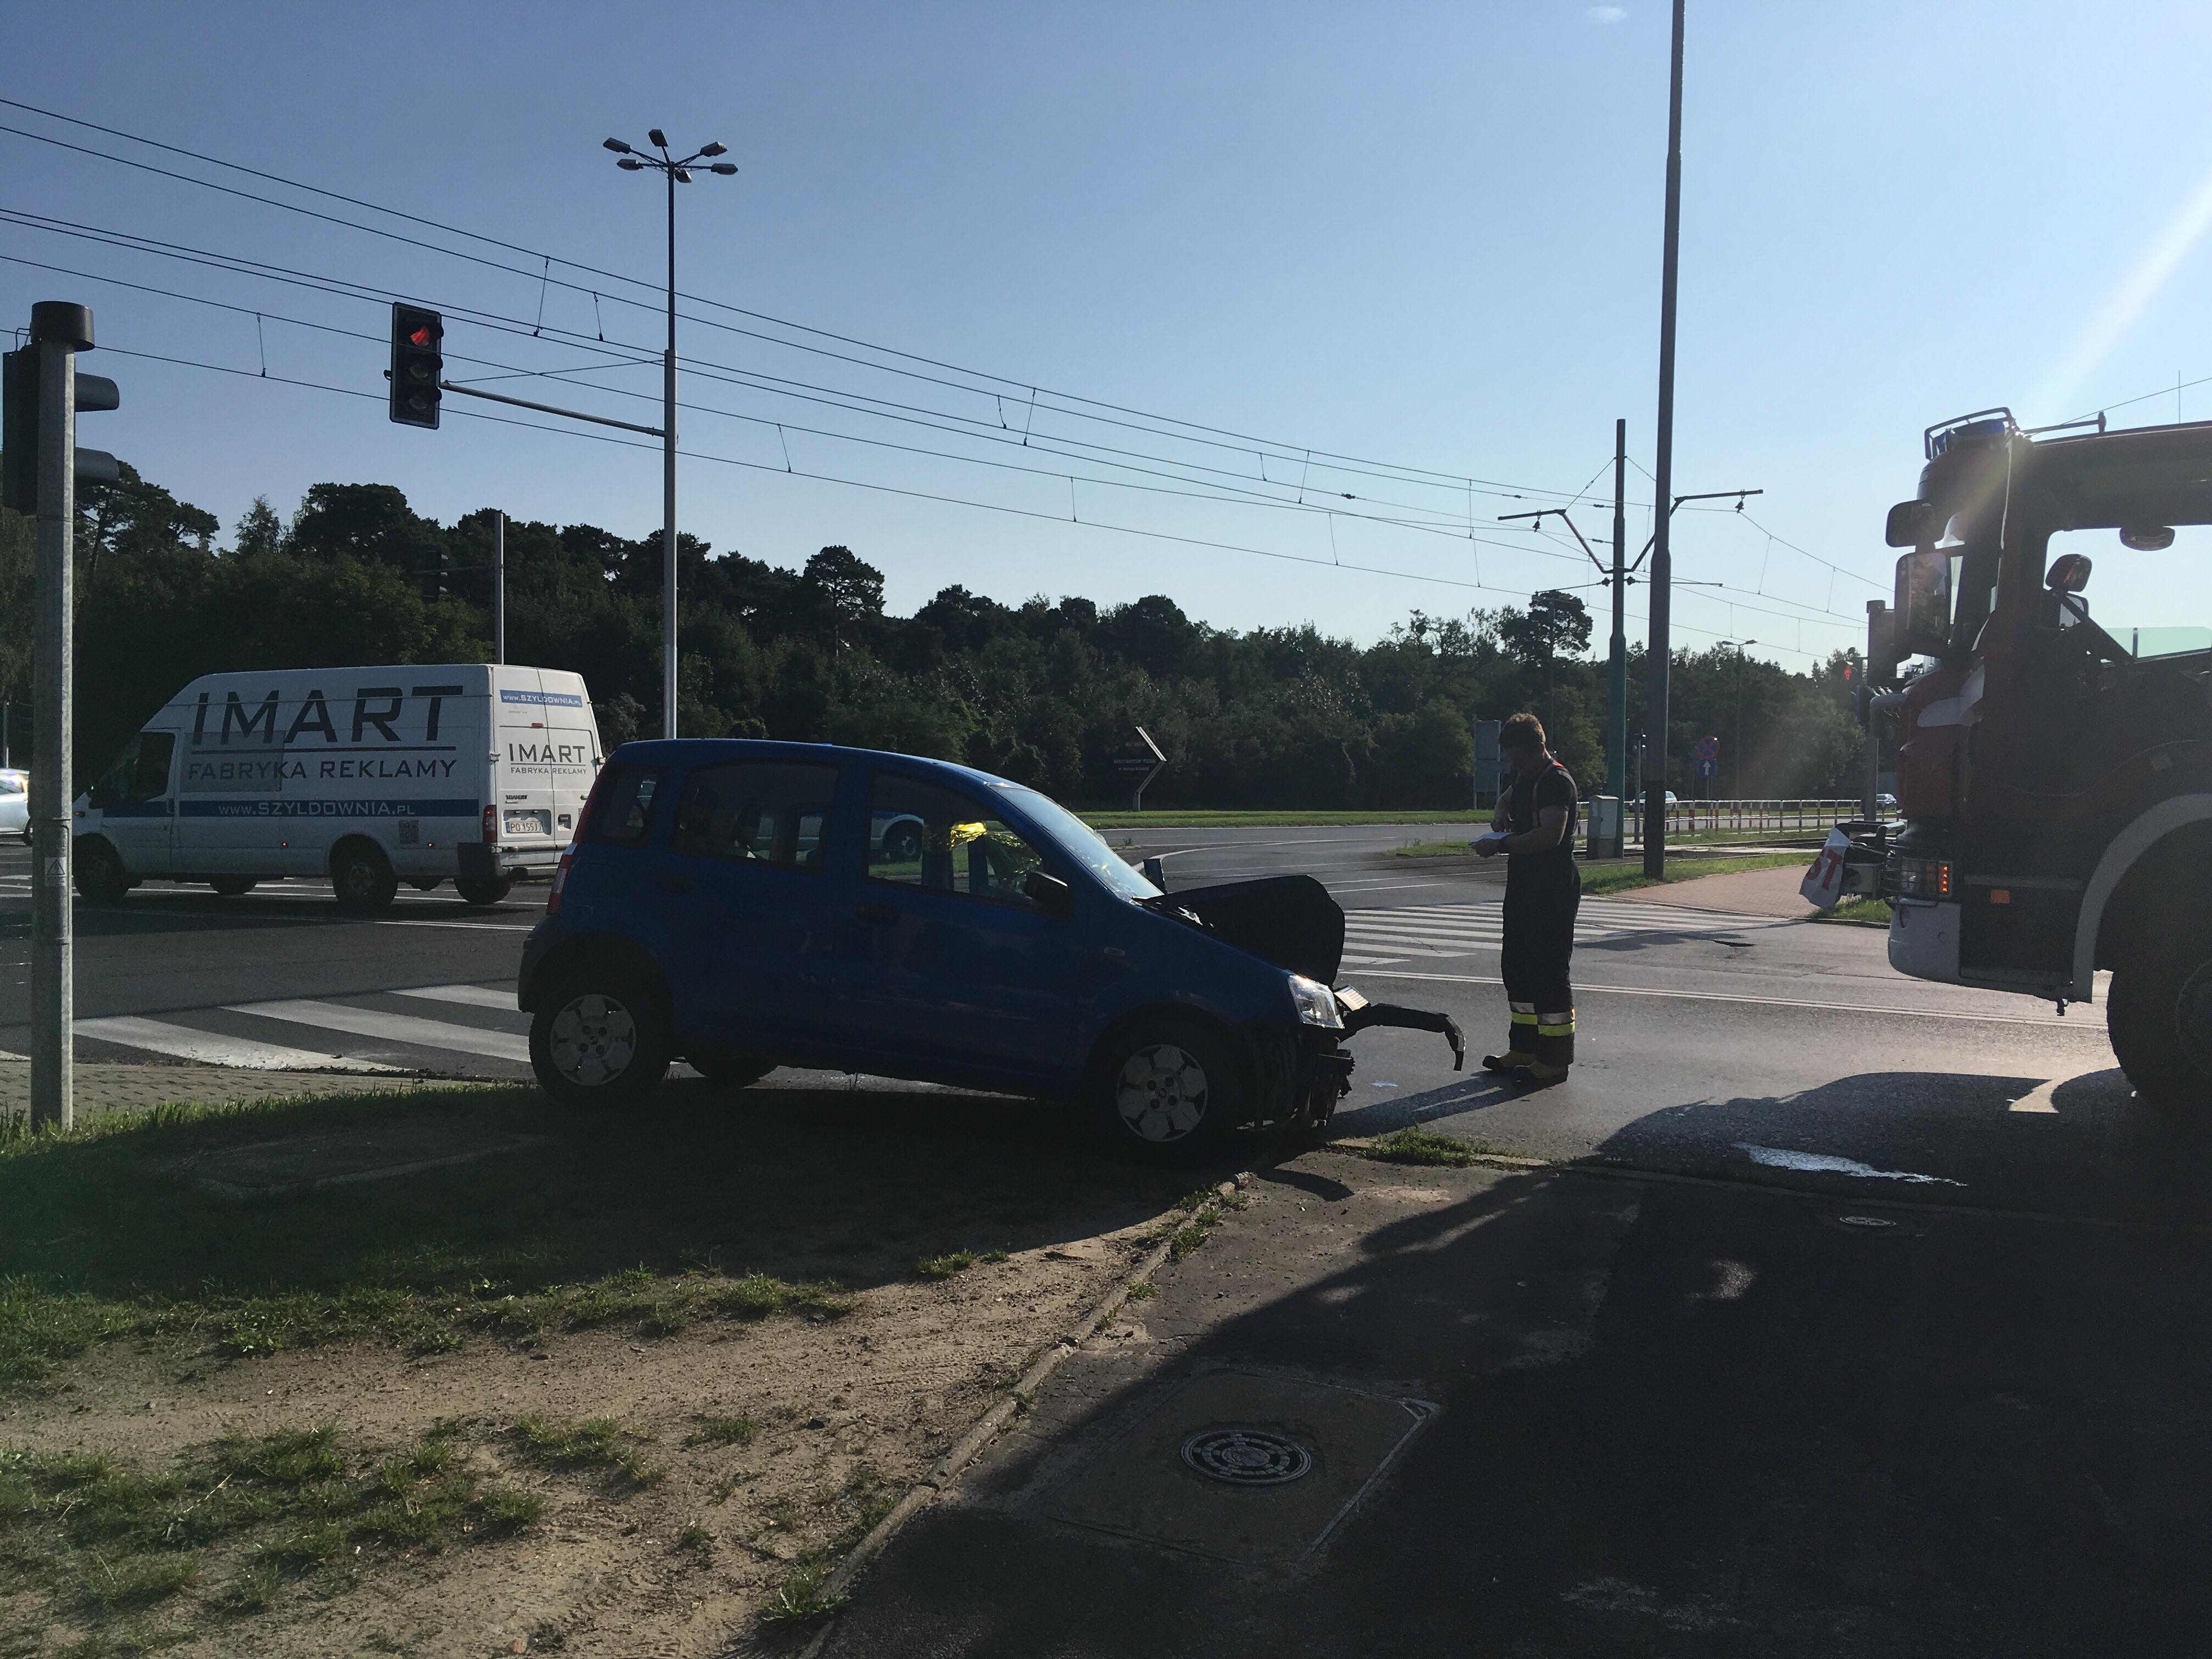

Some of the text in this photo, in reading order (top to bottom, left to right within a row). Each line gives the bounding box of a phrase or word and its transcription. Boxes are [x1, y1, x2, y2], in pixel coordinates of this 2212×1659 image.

[191, 685, 464, 745] IMART
[509, 743, 585, 763] IMART
[188, 759, 457, 780] FABRYKA REKLAMY
[510, 823, 521, 832] PO
